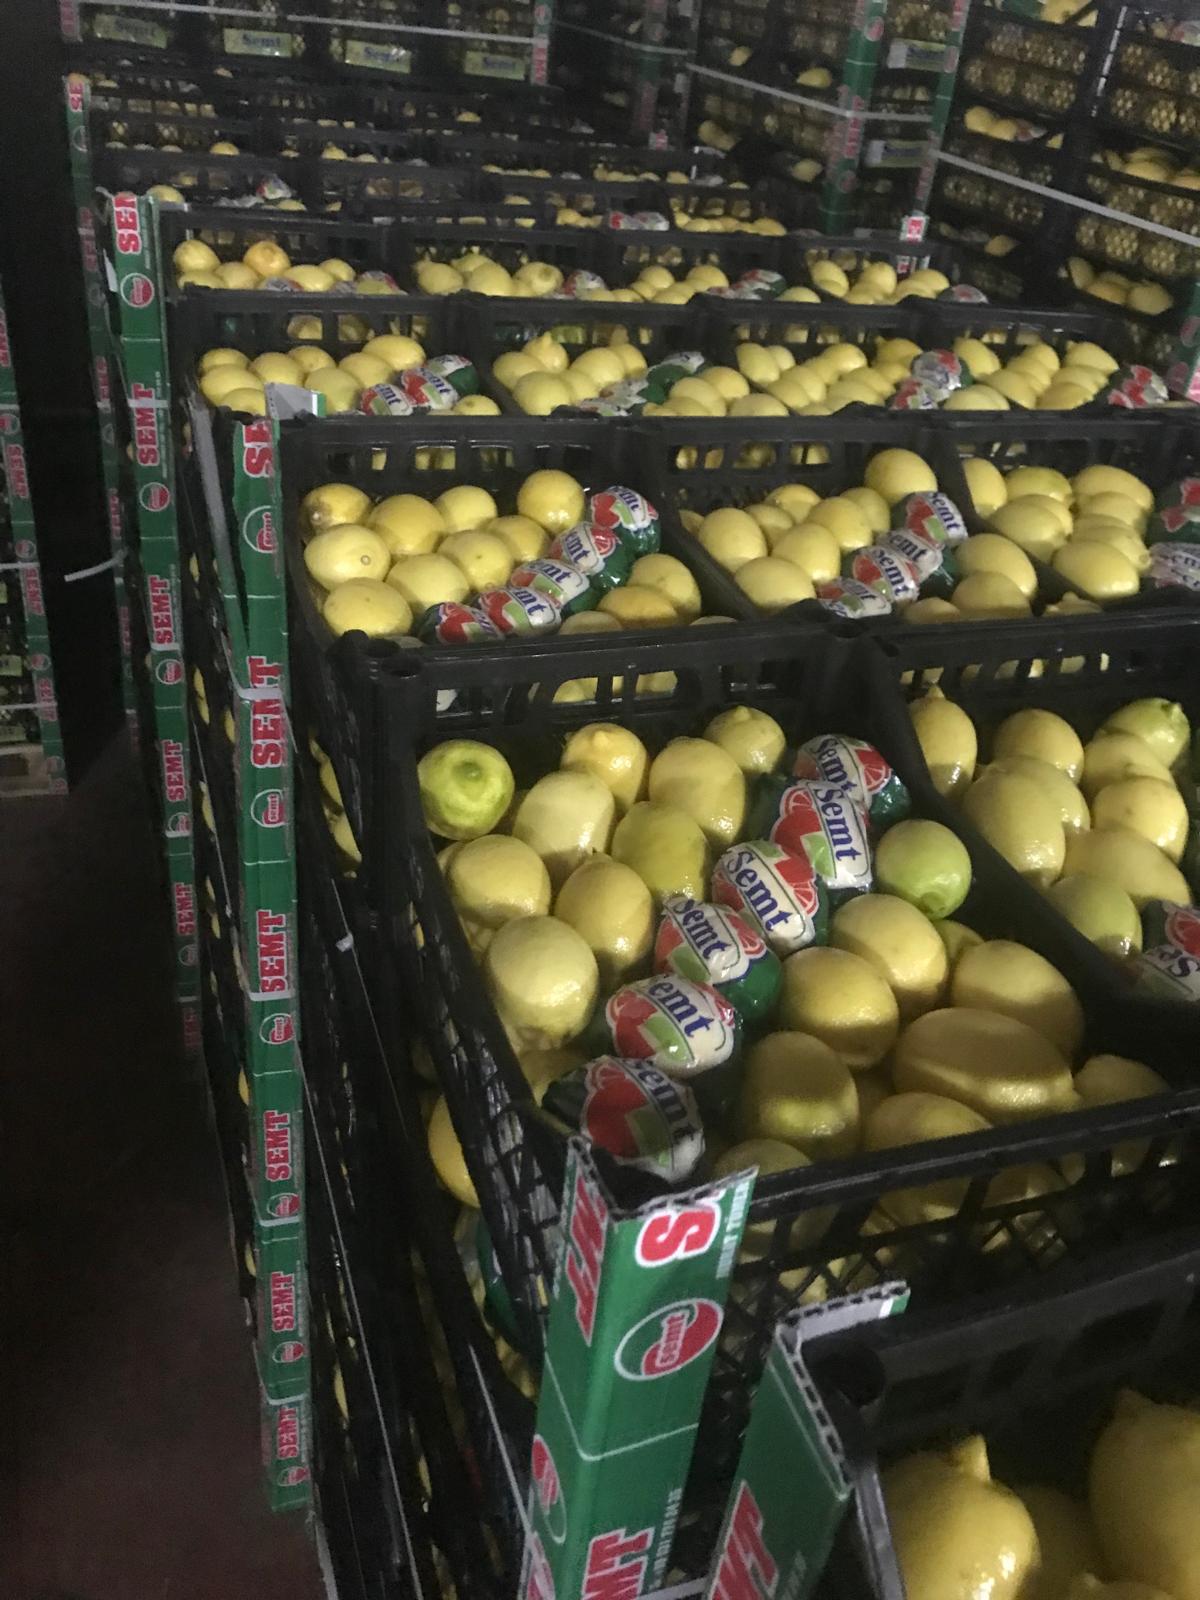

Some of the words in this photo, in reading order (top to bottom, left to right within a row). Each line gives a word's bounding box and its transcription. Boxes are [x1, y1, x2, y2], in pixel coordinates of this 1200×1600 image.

[131, 382, 161, 467] SEMT
[148, 574, 175, 645] SEMT
[162, 739, 187, 802] SEMT
[815, 737, 858, 793] Semt
[813, 788, 863, 863] Semt
[173, 882, 197, 936] SEMT
[725, 850, 794, 933] Semt
[256, 909, 289, 994] SEMT
[648, 974, 715, 1039] emt
[263, 1109, 292, 1182] SEMT
[270, 1271, 297, 1333] SEMT
[277, 1405, 299, 1459] SEMT
